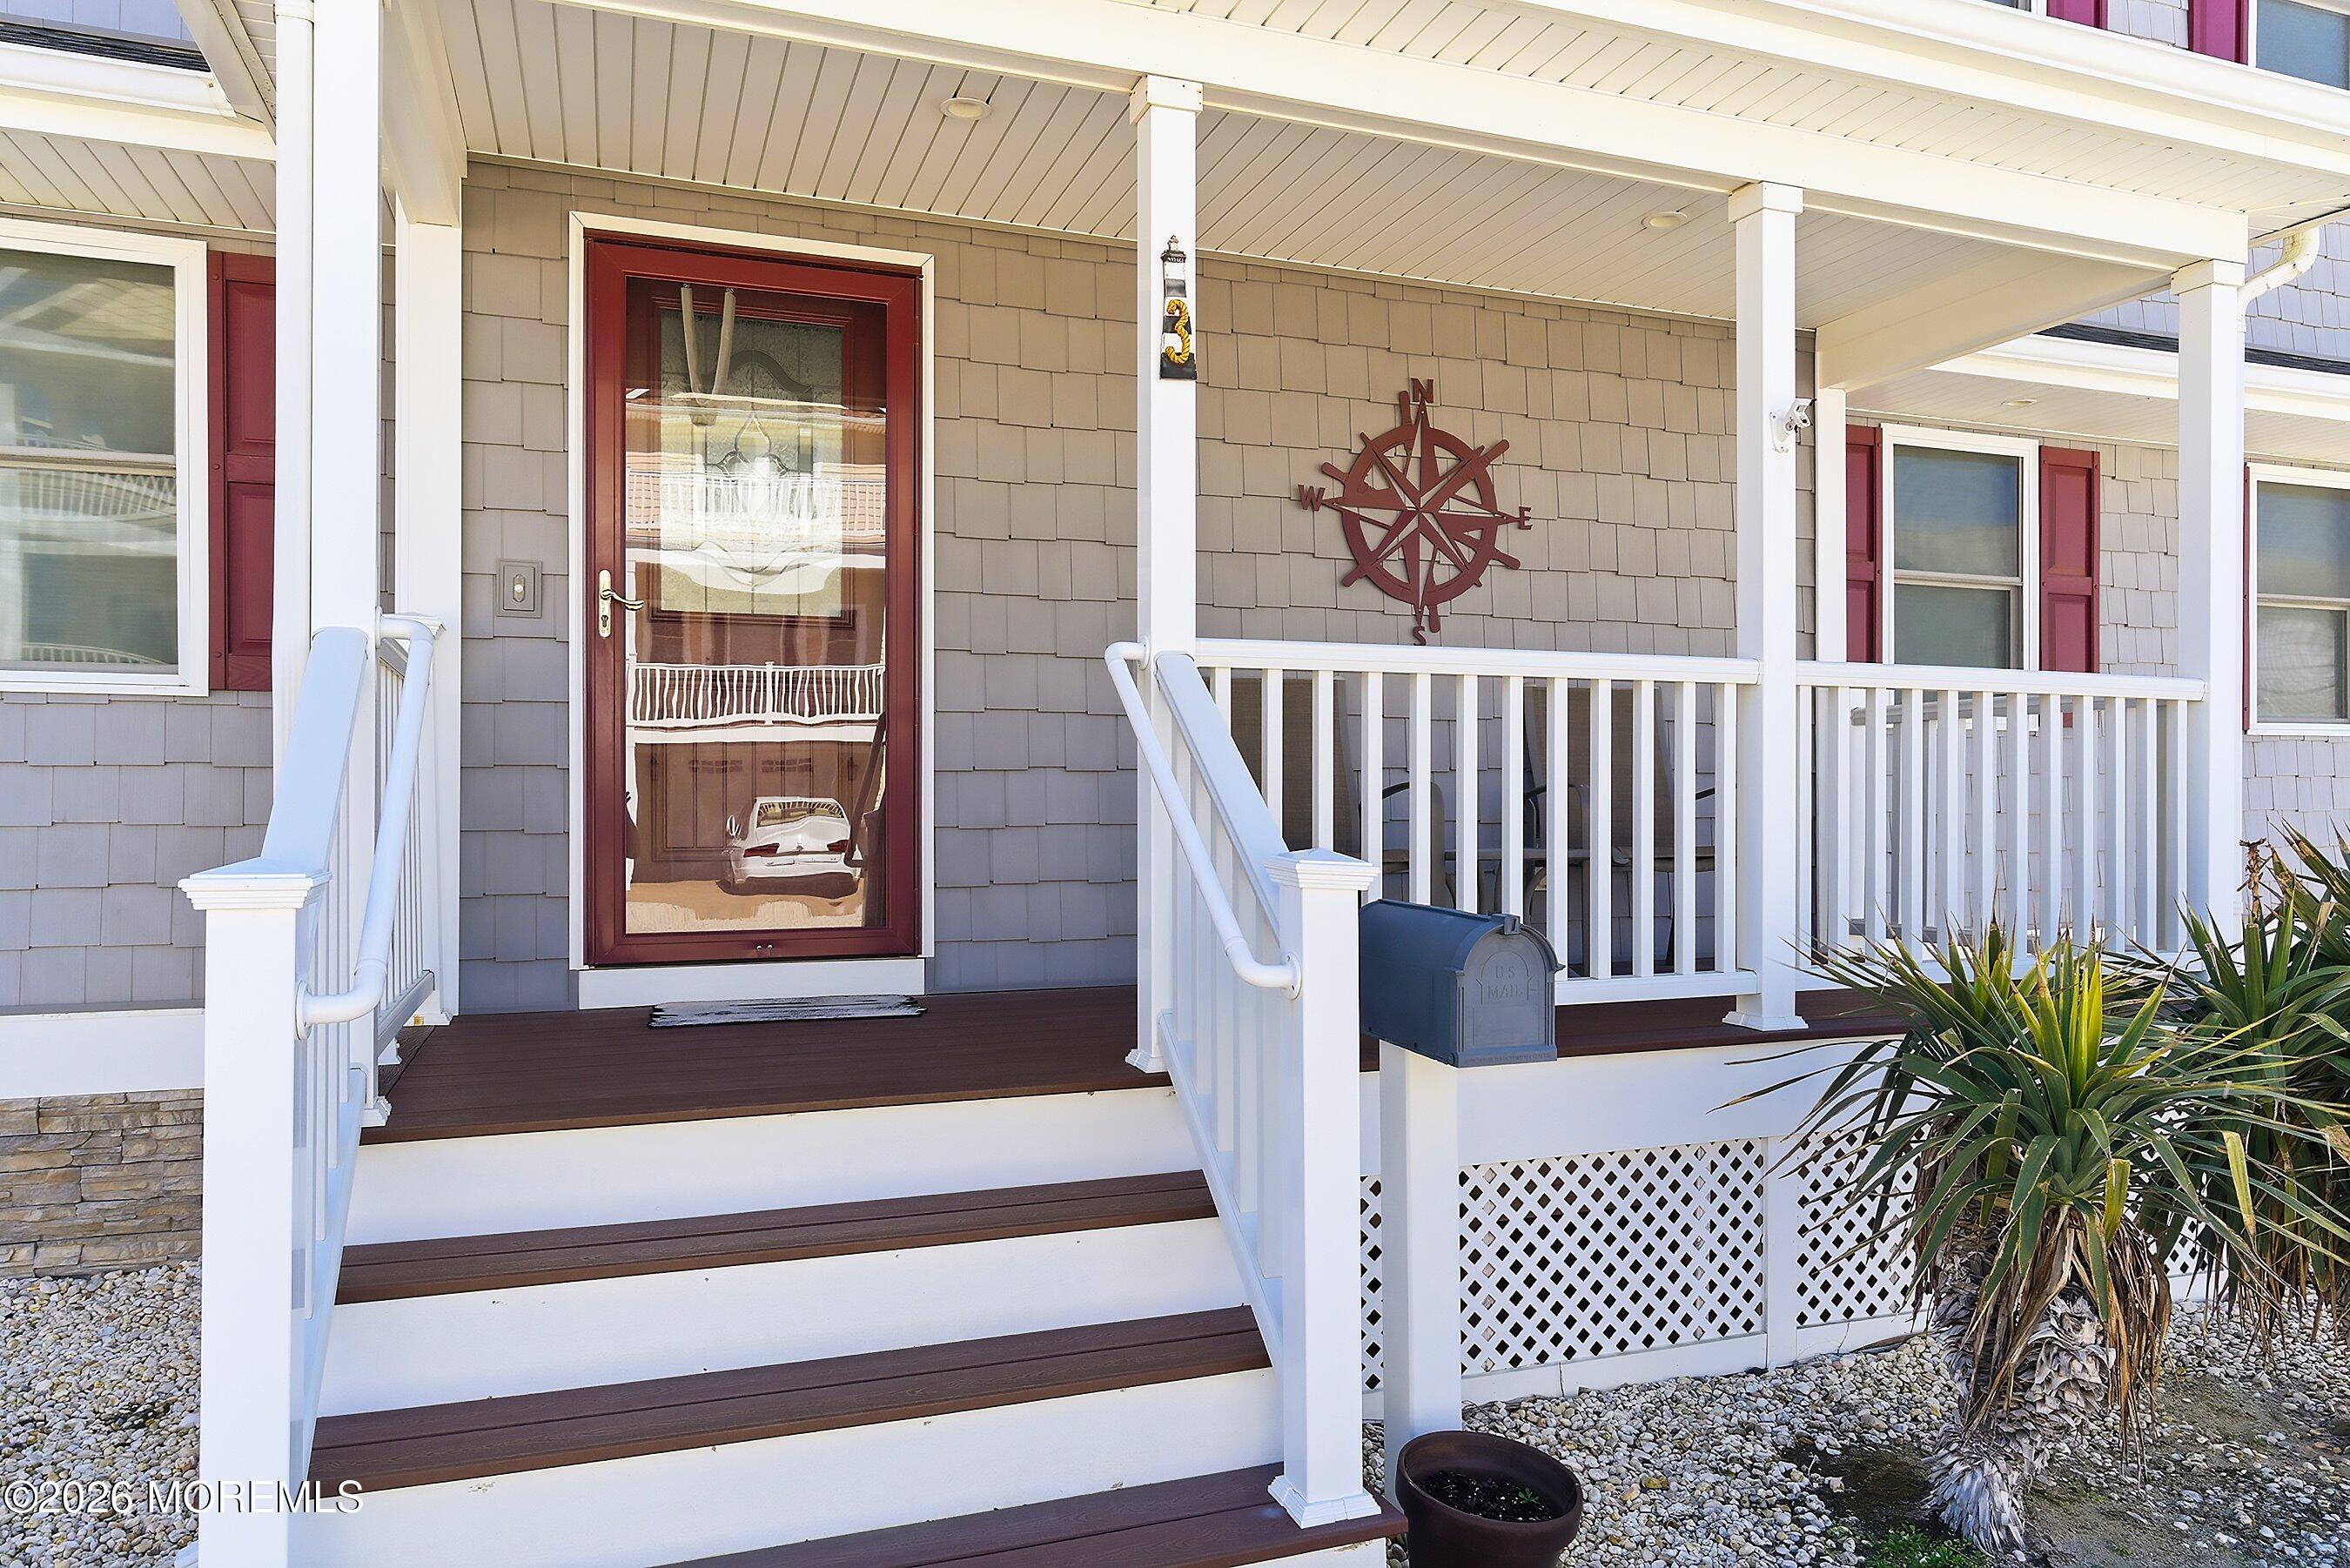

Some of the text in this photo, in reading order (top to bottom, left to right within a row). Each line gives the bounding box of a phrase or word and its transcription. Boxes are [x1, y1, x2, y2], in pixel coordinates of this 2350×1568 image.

[1166, 298, 1191, 365] 3
[1411, 378, 1434, 404] N
[1297, 484, 1326, 512] W
[1518, 506, 1534, 531] E
[1413, 625, 1427, 646] S
[1487, 984, 1523, 1000] MAIL
